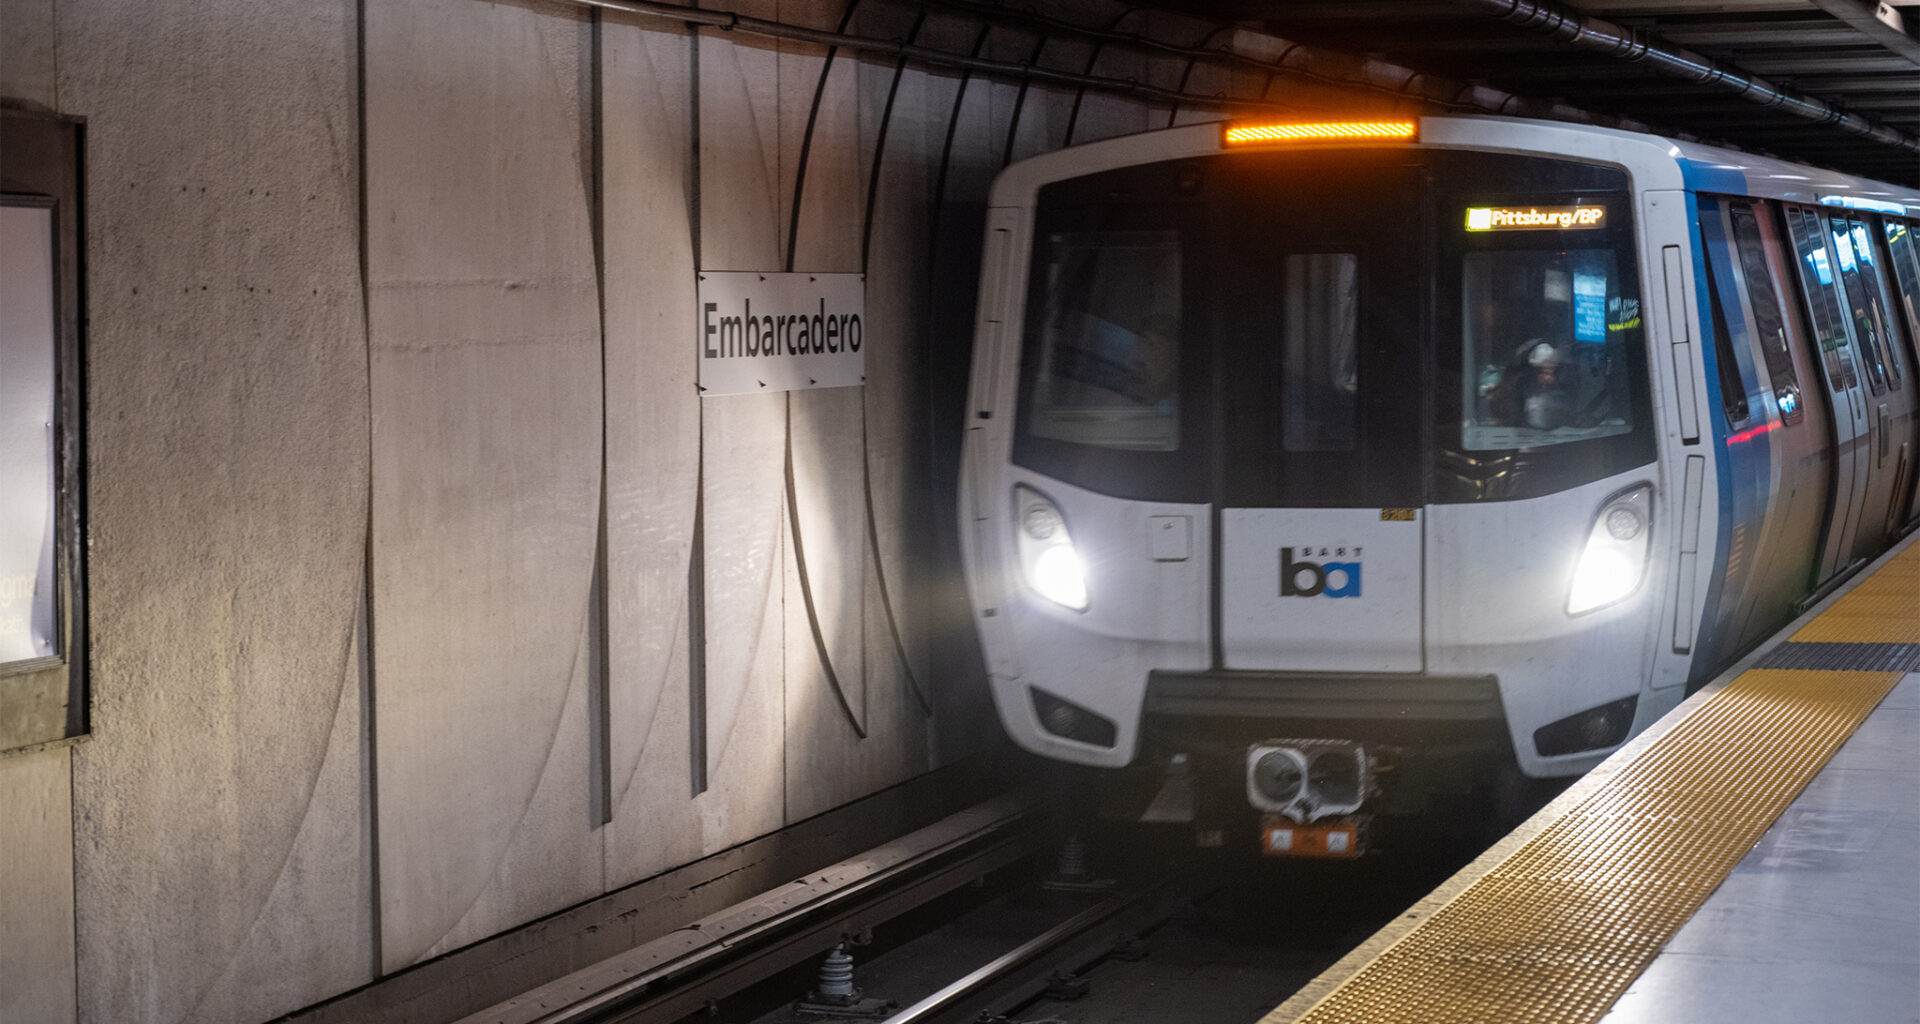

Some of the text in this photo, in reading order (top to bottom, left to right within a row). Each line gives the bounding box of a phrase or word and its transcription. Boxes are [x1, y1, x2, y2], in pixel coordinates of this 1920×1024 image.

[1491, 207, 1603, 228] Pittsburg/BP
[704, 298, 862, 358] Embarcadero
[1302, 547, 1362, 557] BART
